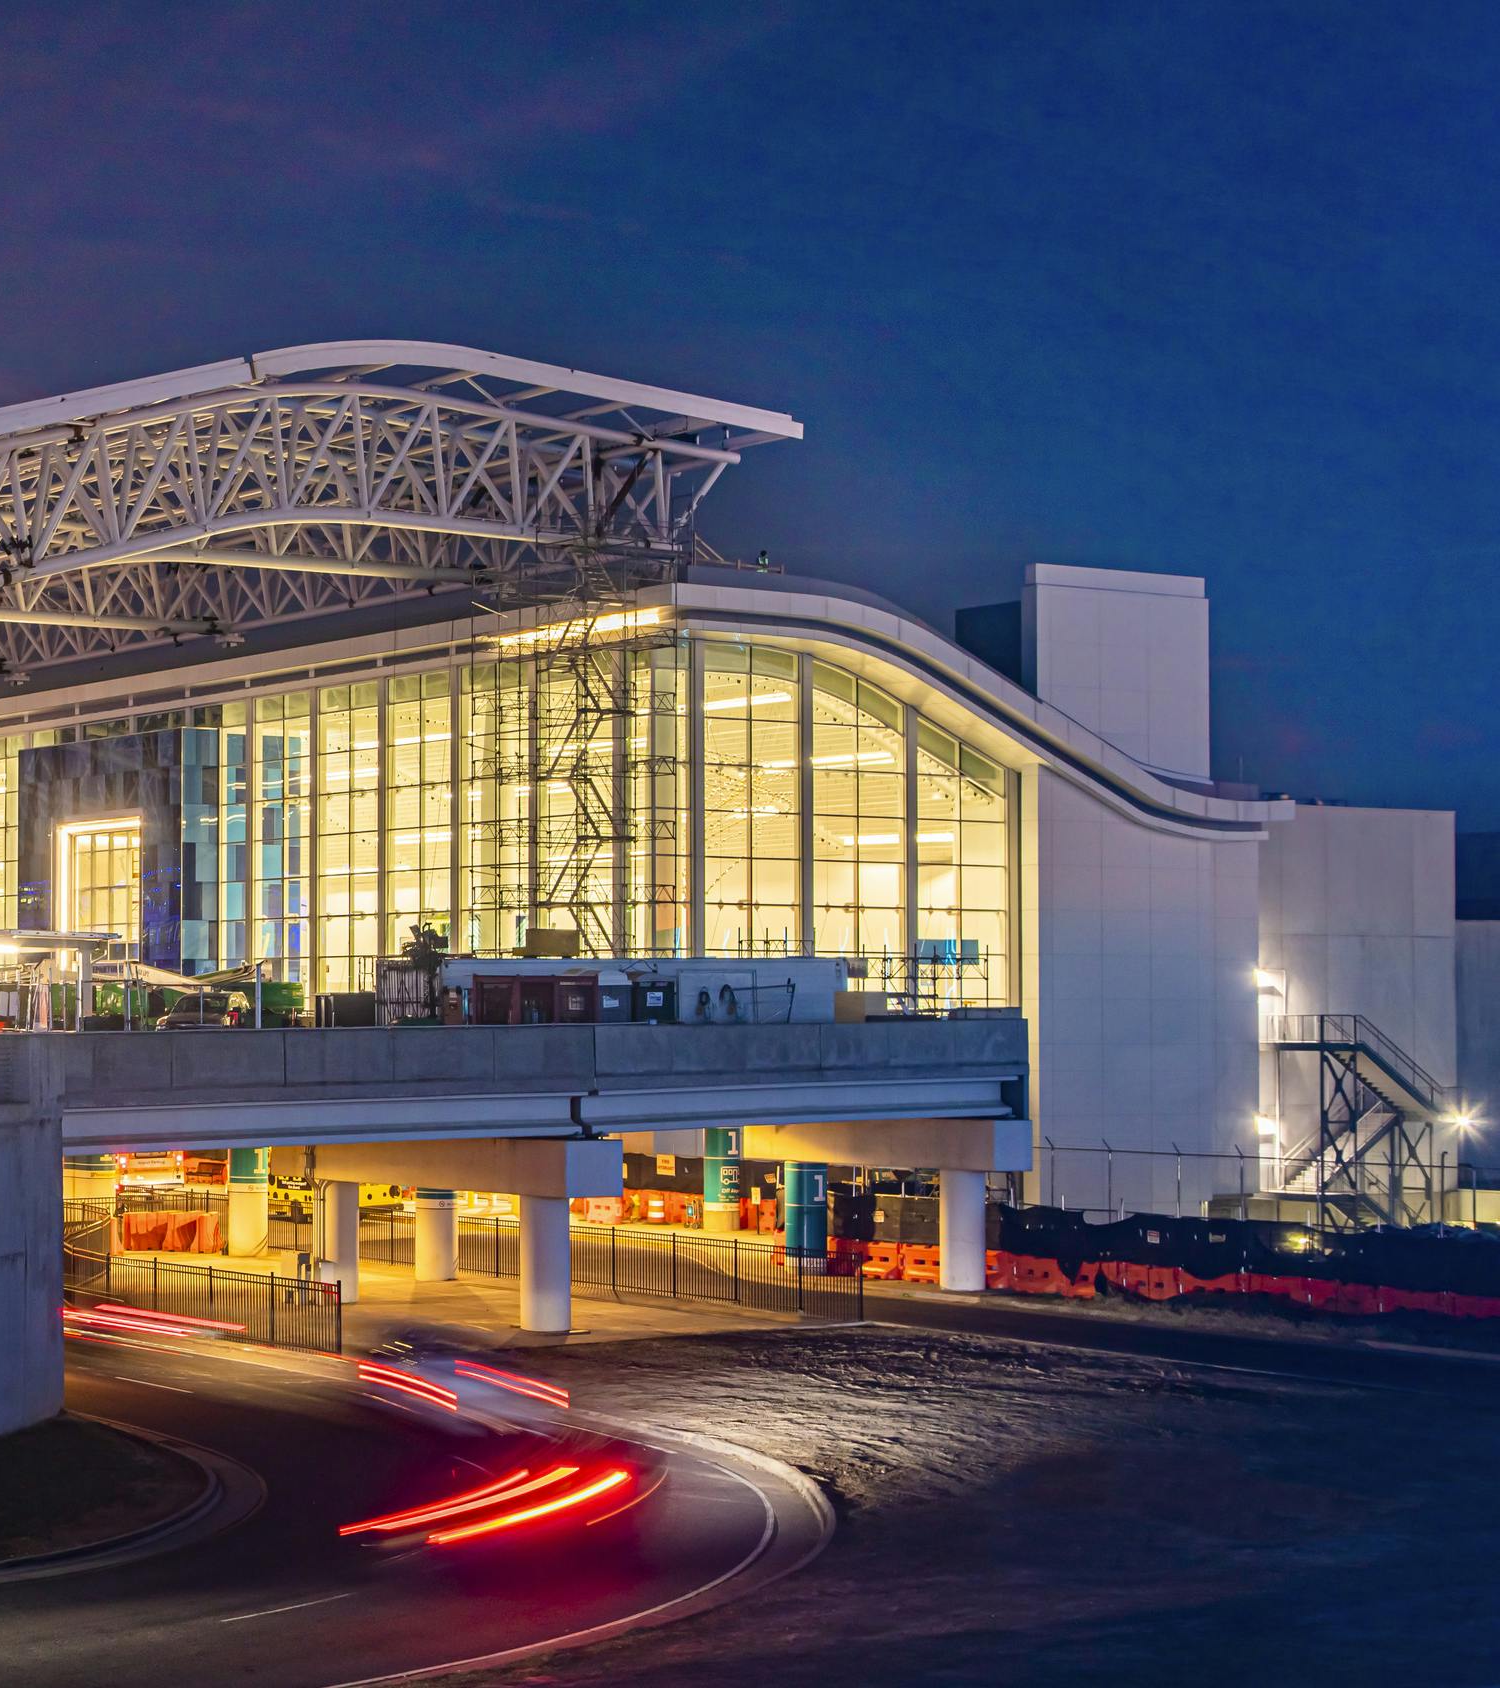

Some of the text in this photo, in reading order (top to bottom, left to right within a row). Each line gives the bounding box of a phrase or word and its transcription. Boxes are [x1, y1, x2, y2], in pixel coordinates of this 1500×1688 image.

[727, 1131, 739, 1155] 1
[253, 1148, 266, 1174] 1
[813, 1174, 826, 1202] 1
